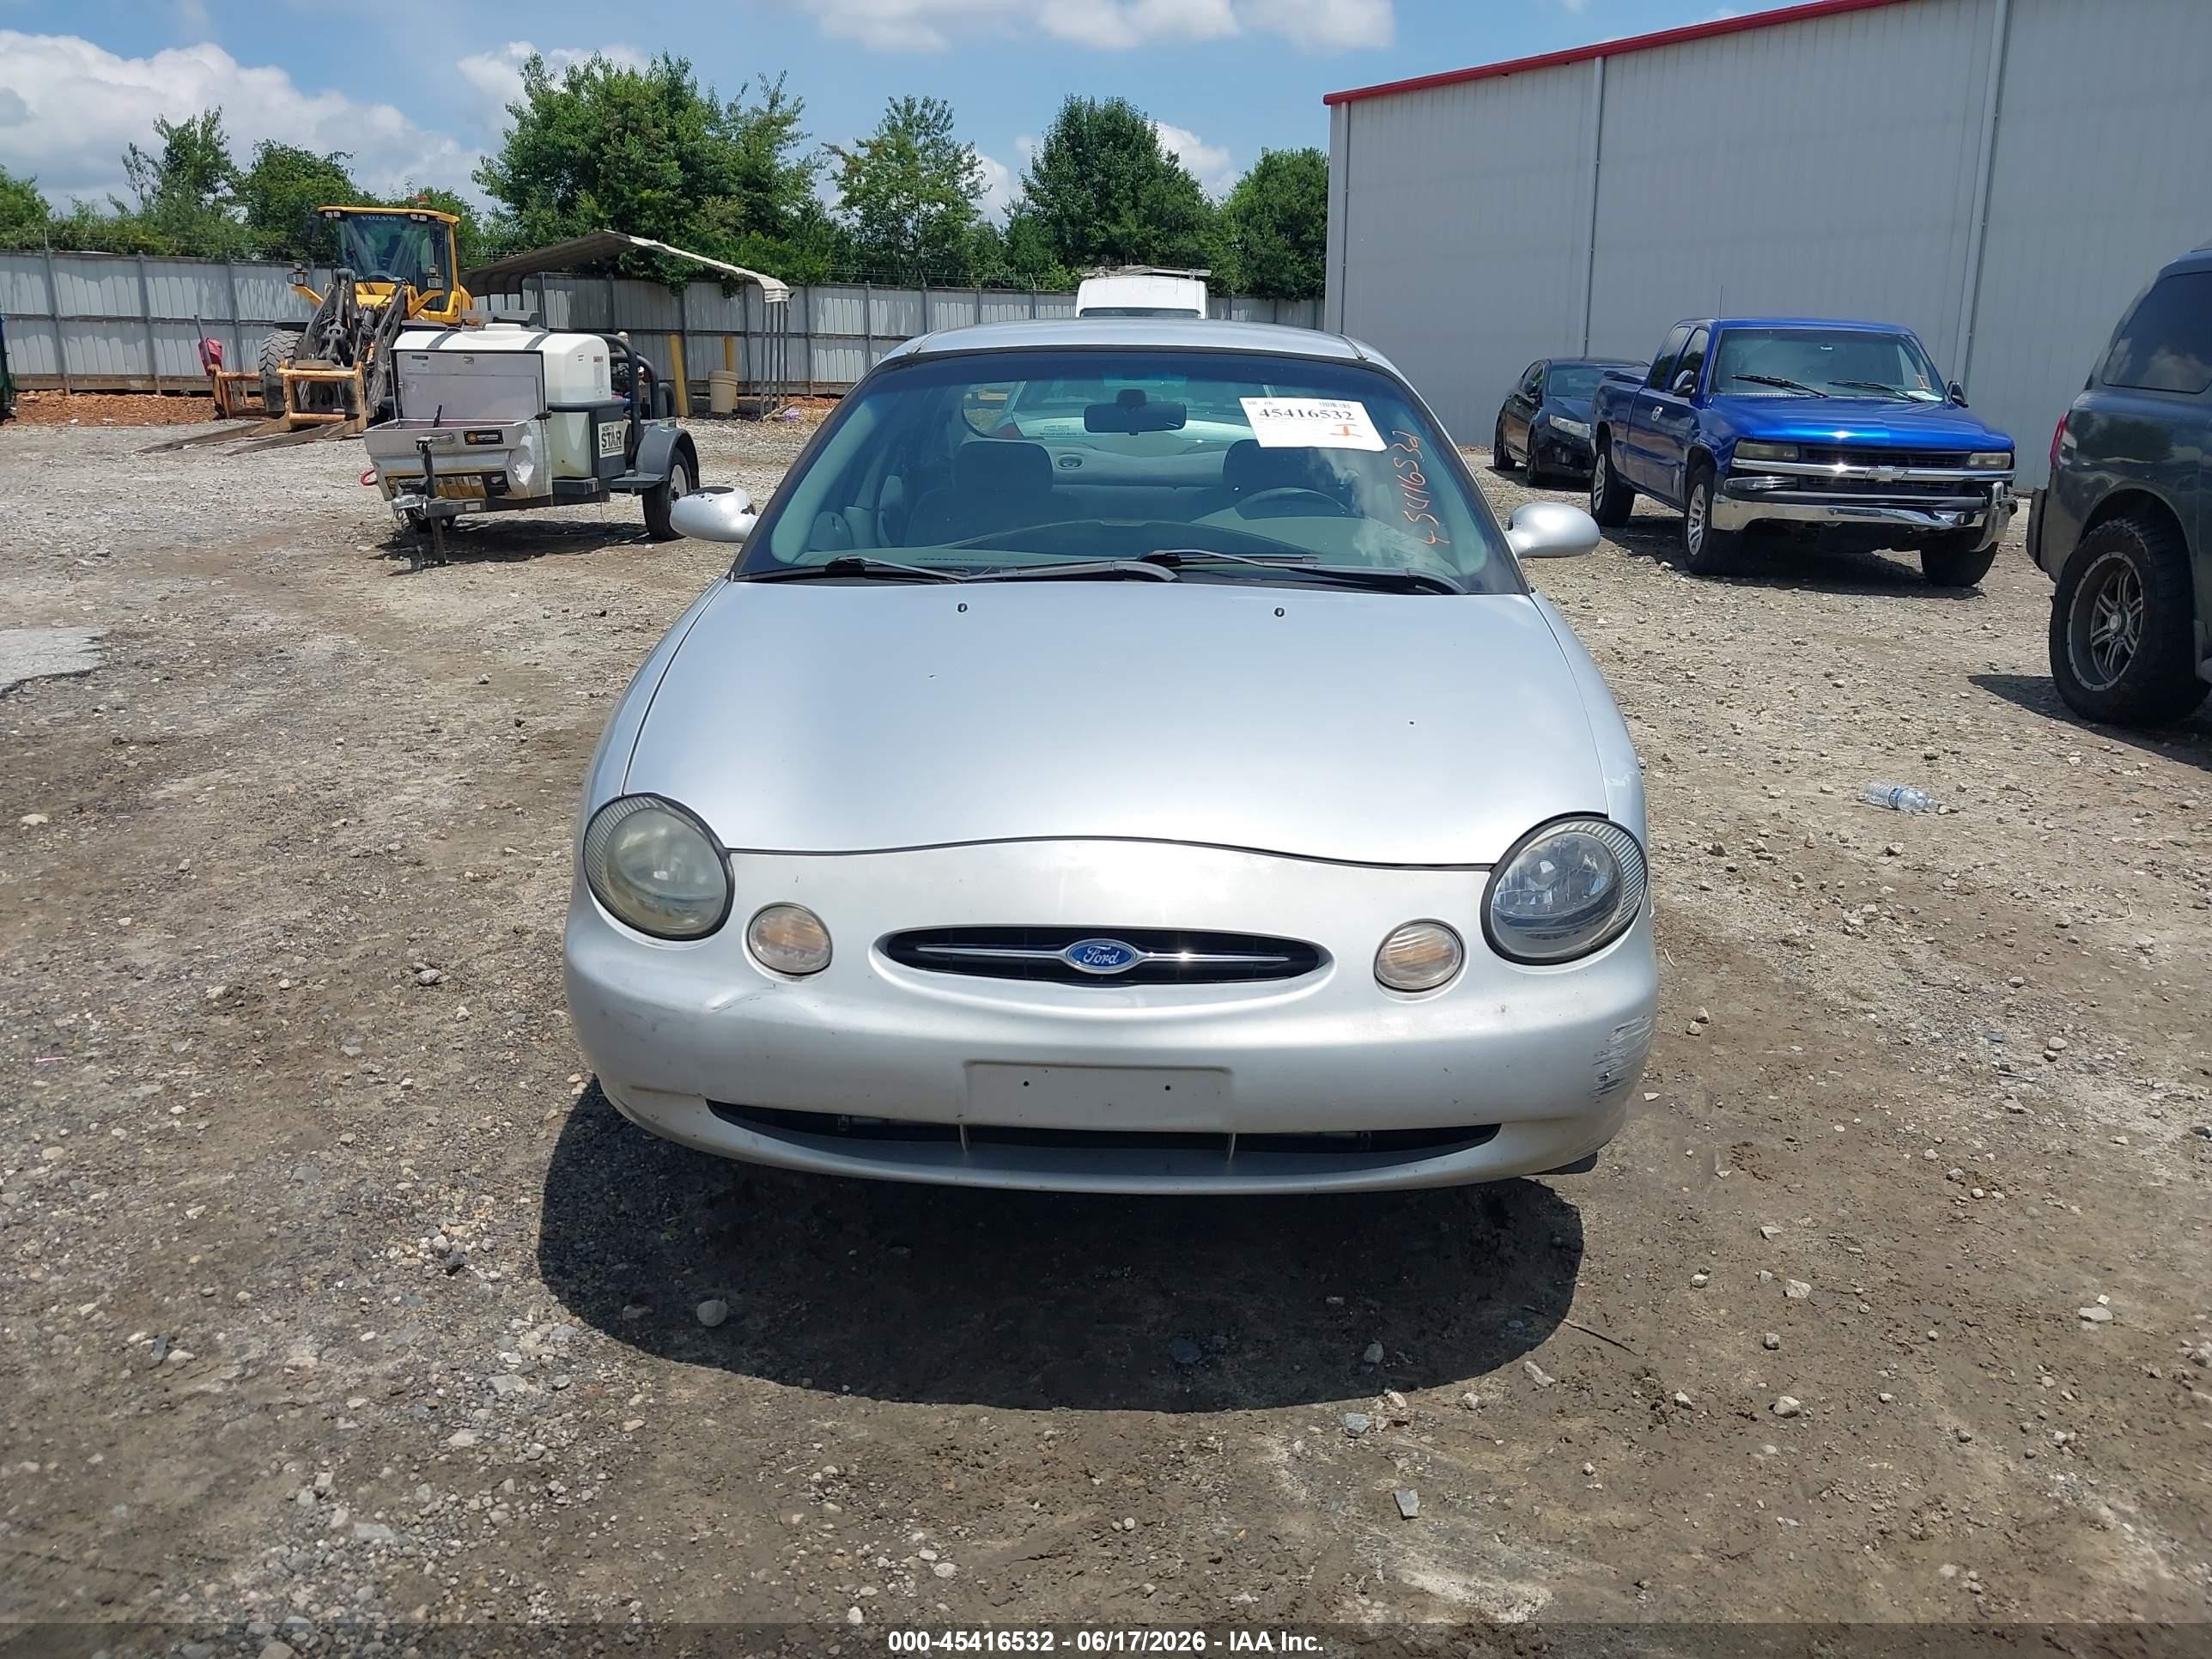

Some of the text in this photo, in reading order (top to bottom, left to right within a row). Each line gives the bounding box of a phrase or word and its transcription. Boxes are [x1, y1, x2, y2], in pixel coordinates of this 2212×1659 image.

[1260, 409, 1354, 420] 45416532
[601, 430, 622, 447] STAR
[1083, 945, 1120, 964] Ford
